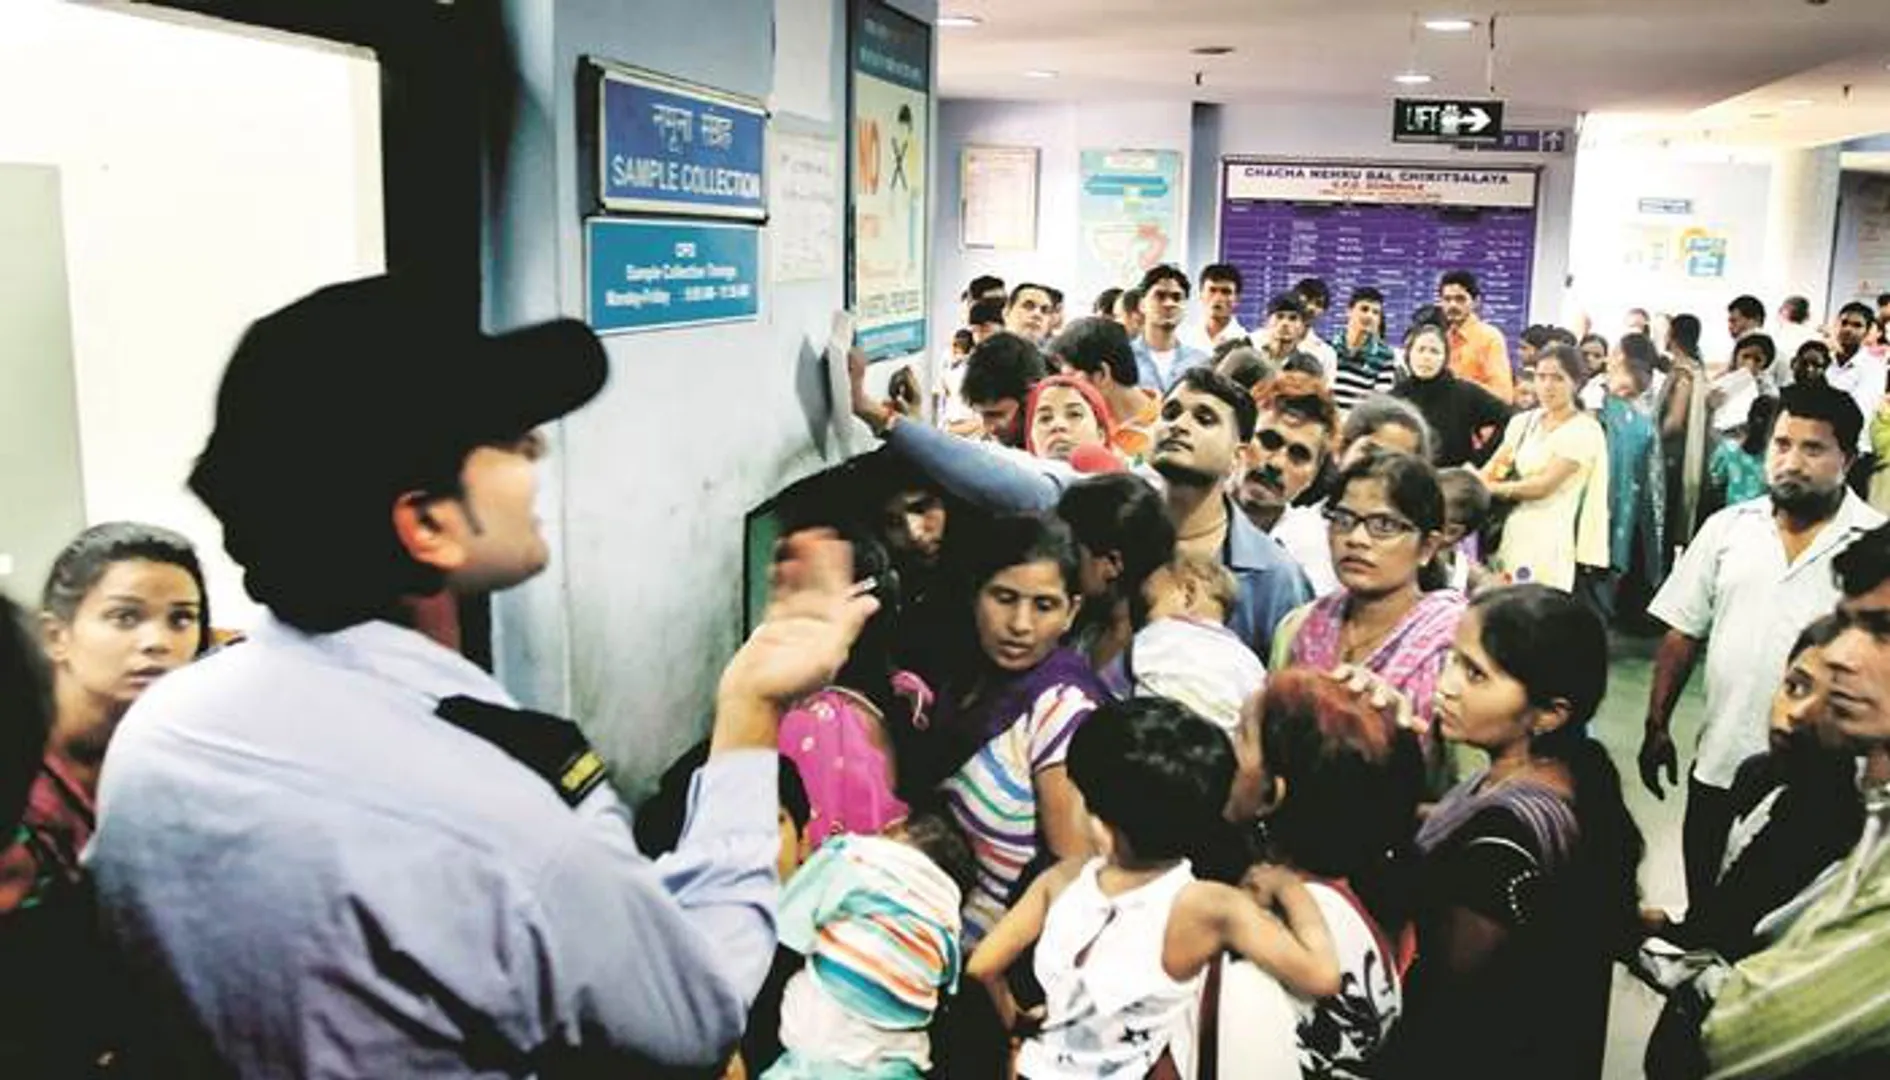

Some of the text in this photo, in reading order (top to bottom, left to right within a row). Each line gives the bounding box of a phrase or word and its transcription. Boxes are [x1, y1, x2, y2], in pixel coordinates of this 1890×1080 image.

[1406, 104, 1440, 131] LIFT
[611, 154, 761, 199] SAMPLE COLLECTION
[1244, 166, 1305, 179] CHACHA
[1309, 169, 1362, 180] NEHRU
